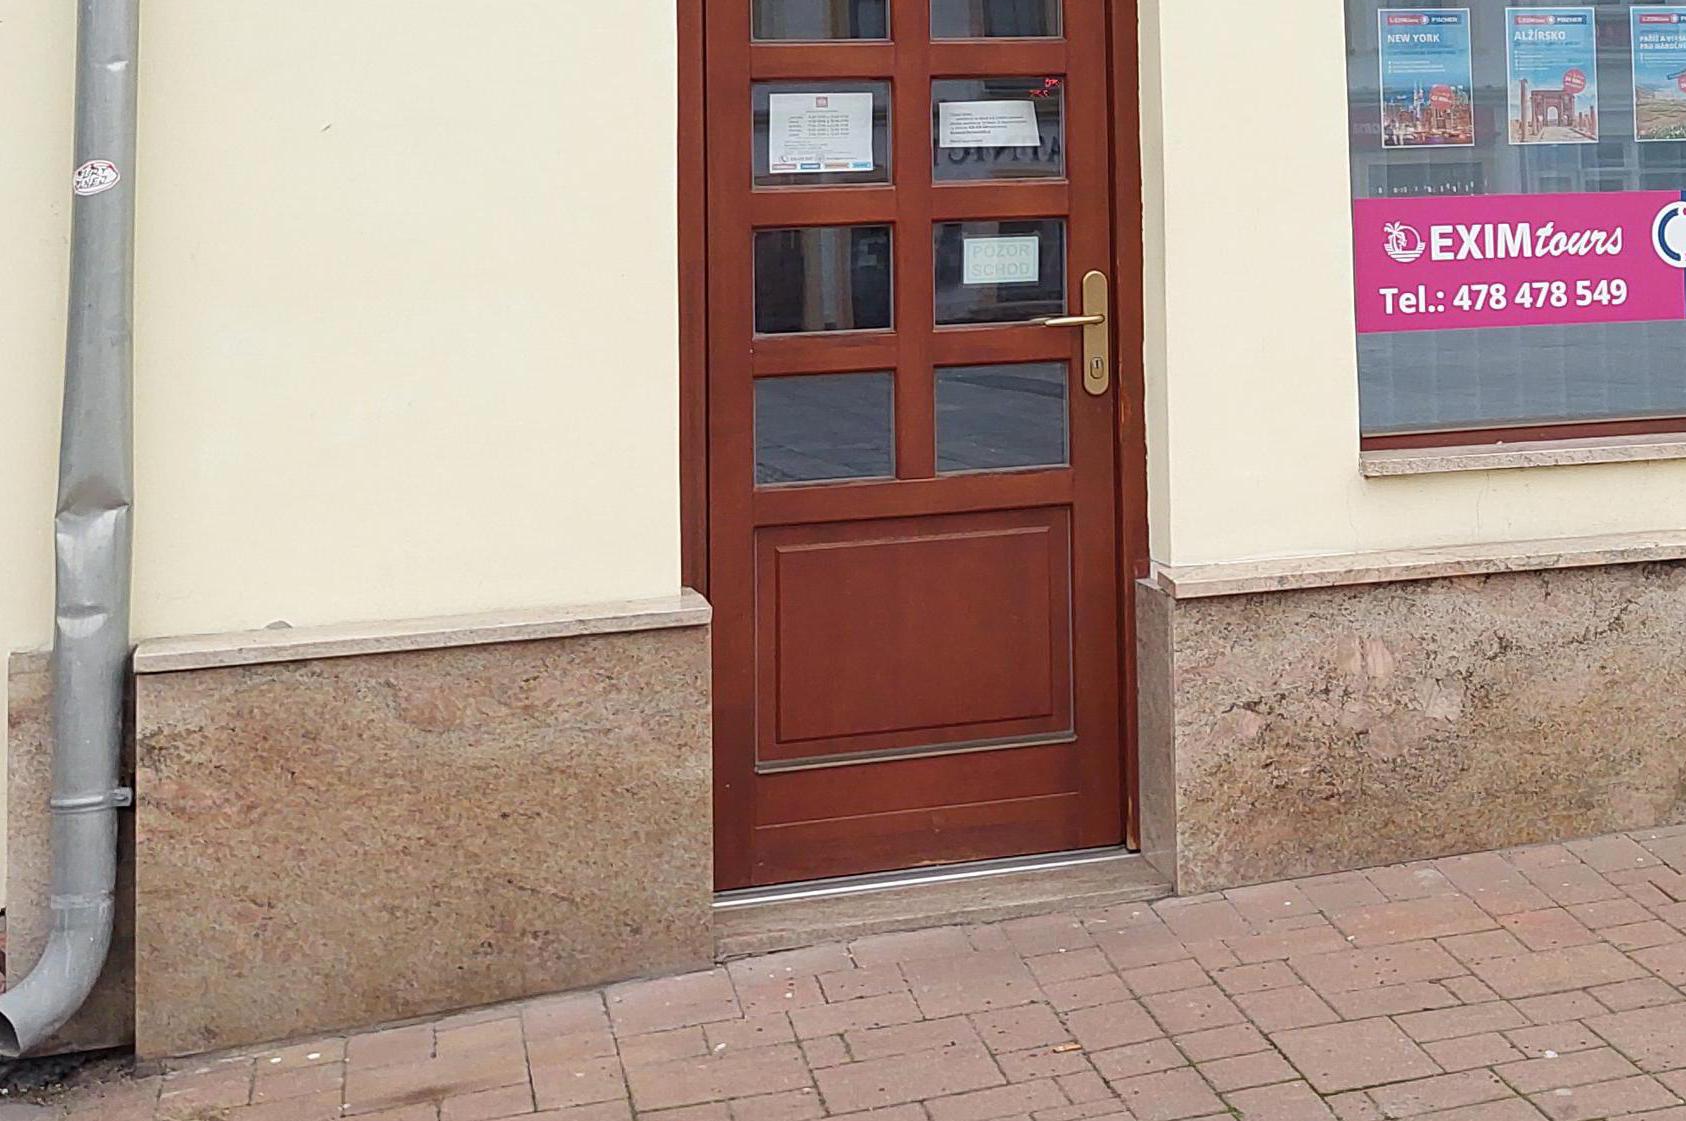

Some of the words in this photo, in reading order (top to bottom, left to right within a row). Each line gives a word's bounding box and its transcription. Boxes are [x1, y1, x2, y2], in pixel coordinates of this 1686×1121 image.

[1387, 33, 1410, 43] NEW
[1412, 33, 1440, 43] YORK
[1514, 28, 1566, 41] ALŽÍRSKO
[972, 244, 1031, 257] POZOR
[971, 263, 1029, 276] SCHOD
[1379, 285, 1445, 314] Tel.:
[1453, 284, 1507, 311] 478
[1514, 281, 1568, 308] 478
[1575, 278, 1627, 305] 549
